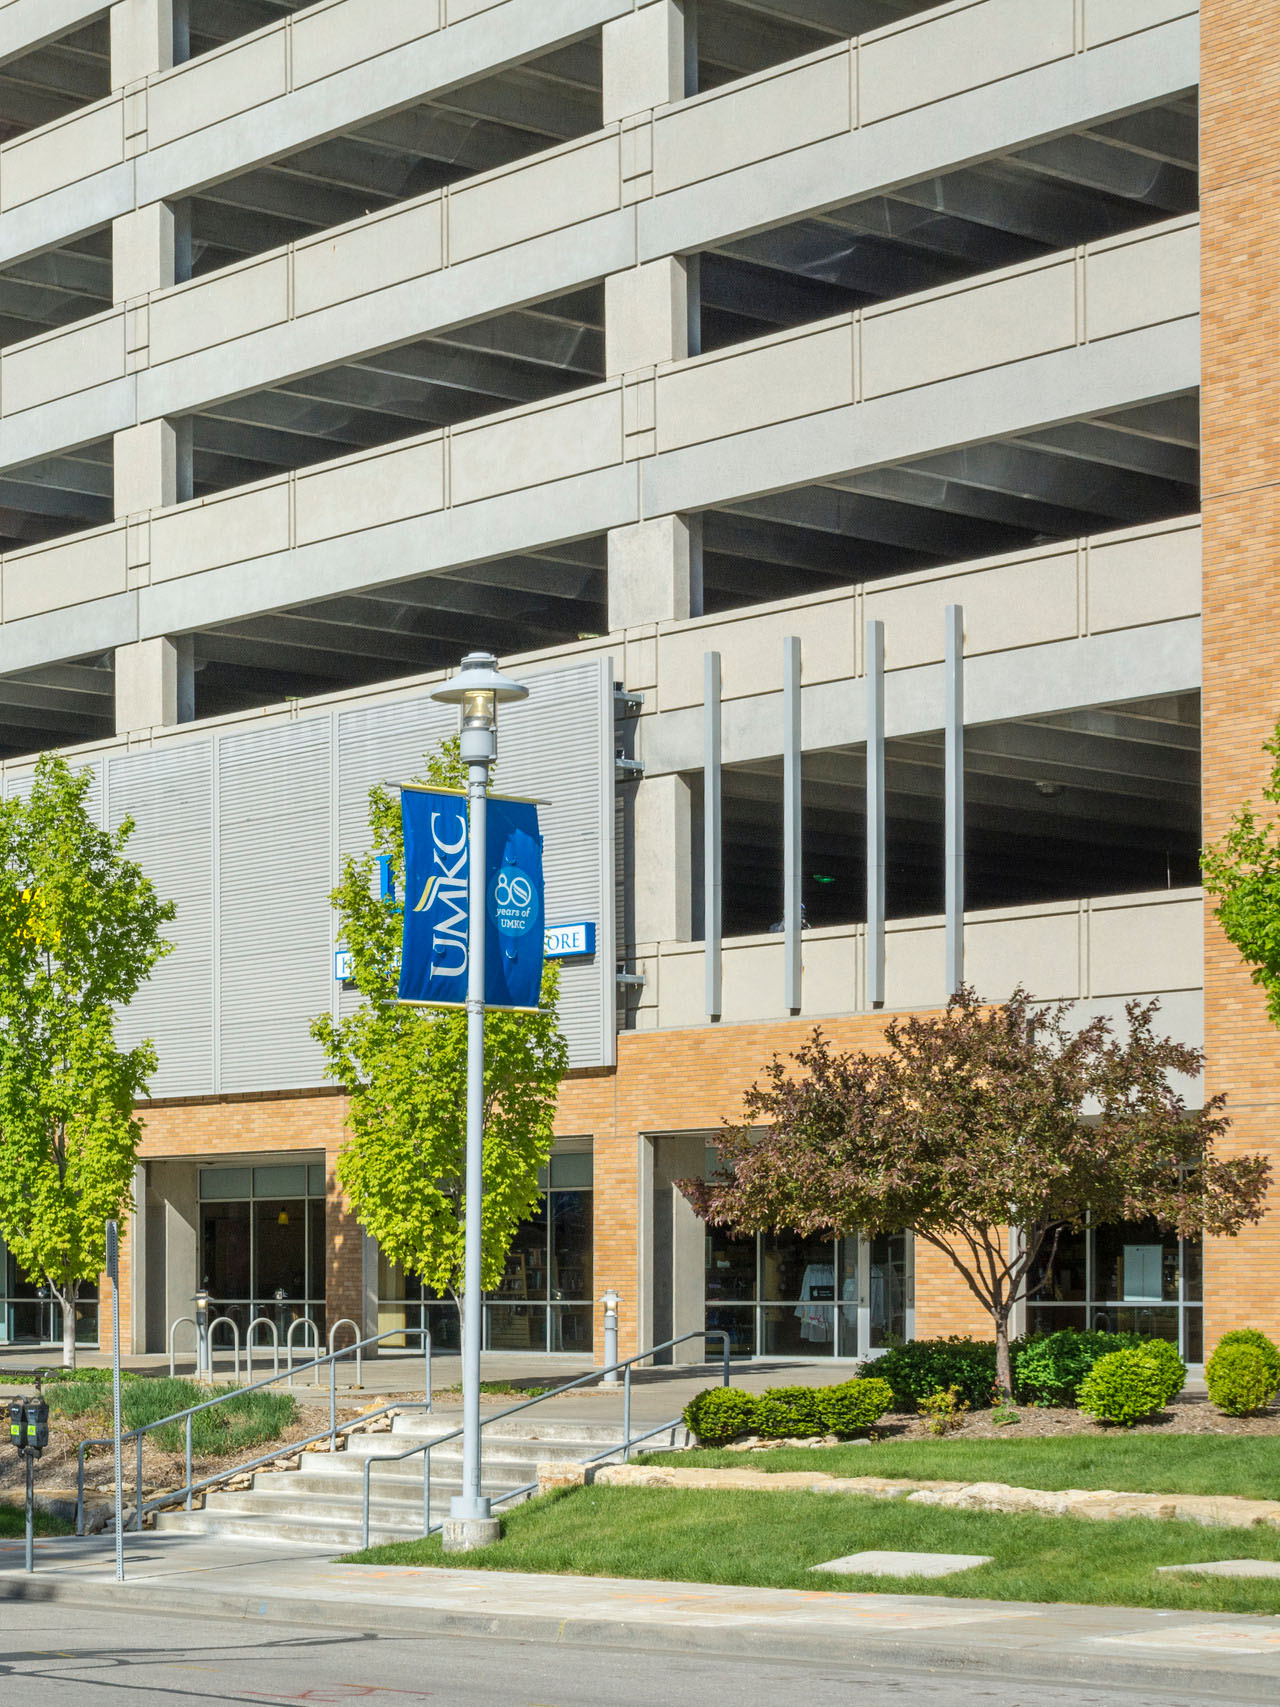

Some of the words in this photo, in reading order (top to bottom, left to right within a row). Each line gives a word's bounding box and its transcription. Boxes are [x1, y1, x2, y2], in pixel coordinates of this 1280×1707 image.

[423, 812, 469, 981] UMKC
[494, 873, 532, 908] 80
[495, 908, 520, 917] years
[521, 907, 532, 917] of
[501, 918, 526, 930] UMKC
